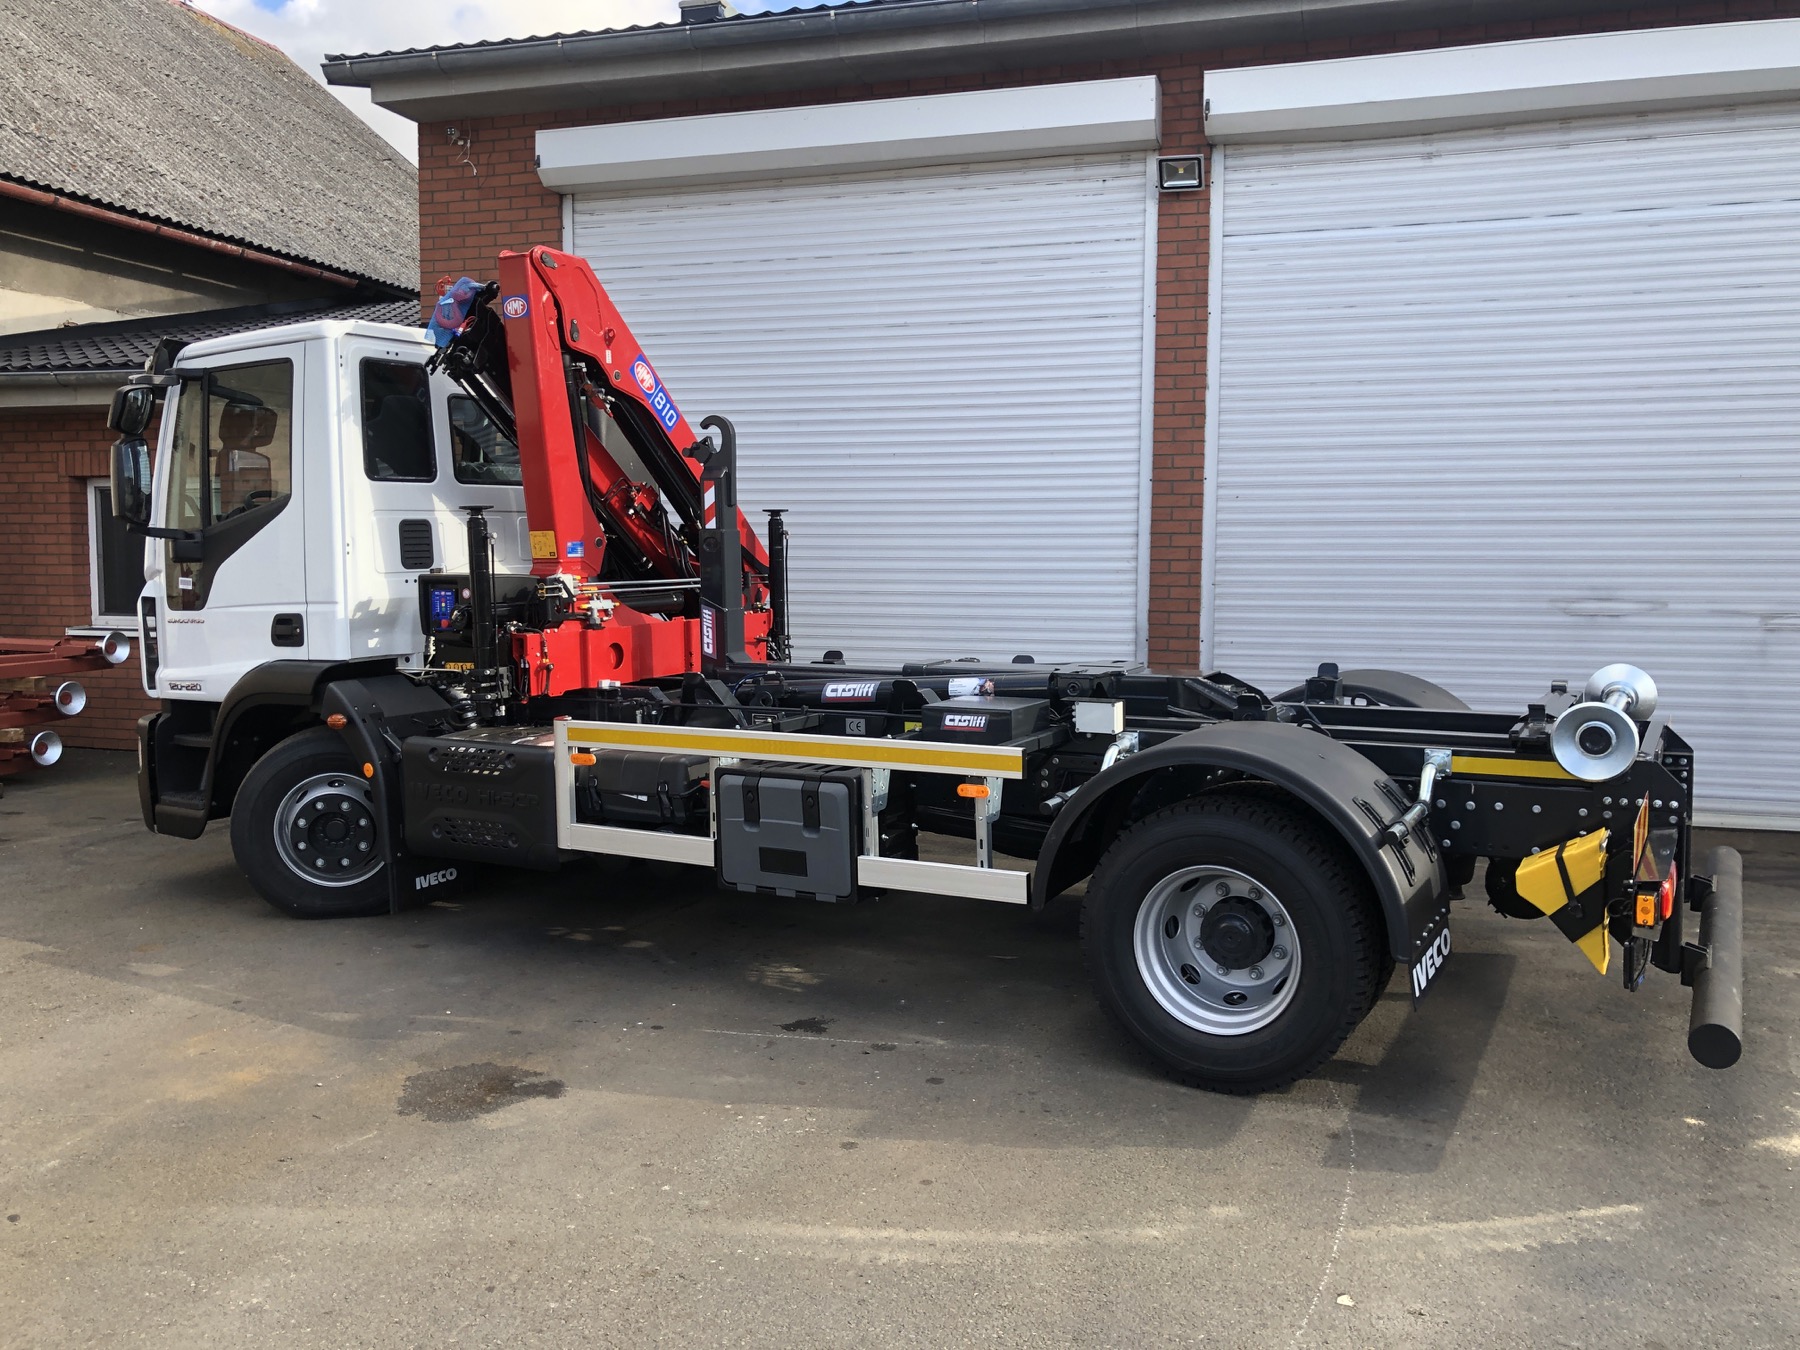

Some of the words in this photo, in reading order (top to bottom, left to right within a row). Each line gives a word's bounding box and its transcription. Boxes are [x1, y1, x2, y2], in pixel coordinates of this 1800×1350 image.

[636, 364, 654, 389] HMF
[654, 392, 677, 427] 810
[825, 683, 876, 697] CTSlift
[849, 720, 862, 732] CE
[944, 714, 986, 727] CTSlift
[415, 867, 458, 890] IVECO
[1412, 928, 1451, 997] IVECO
